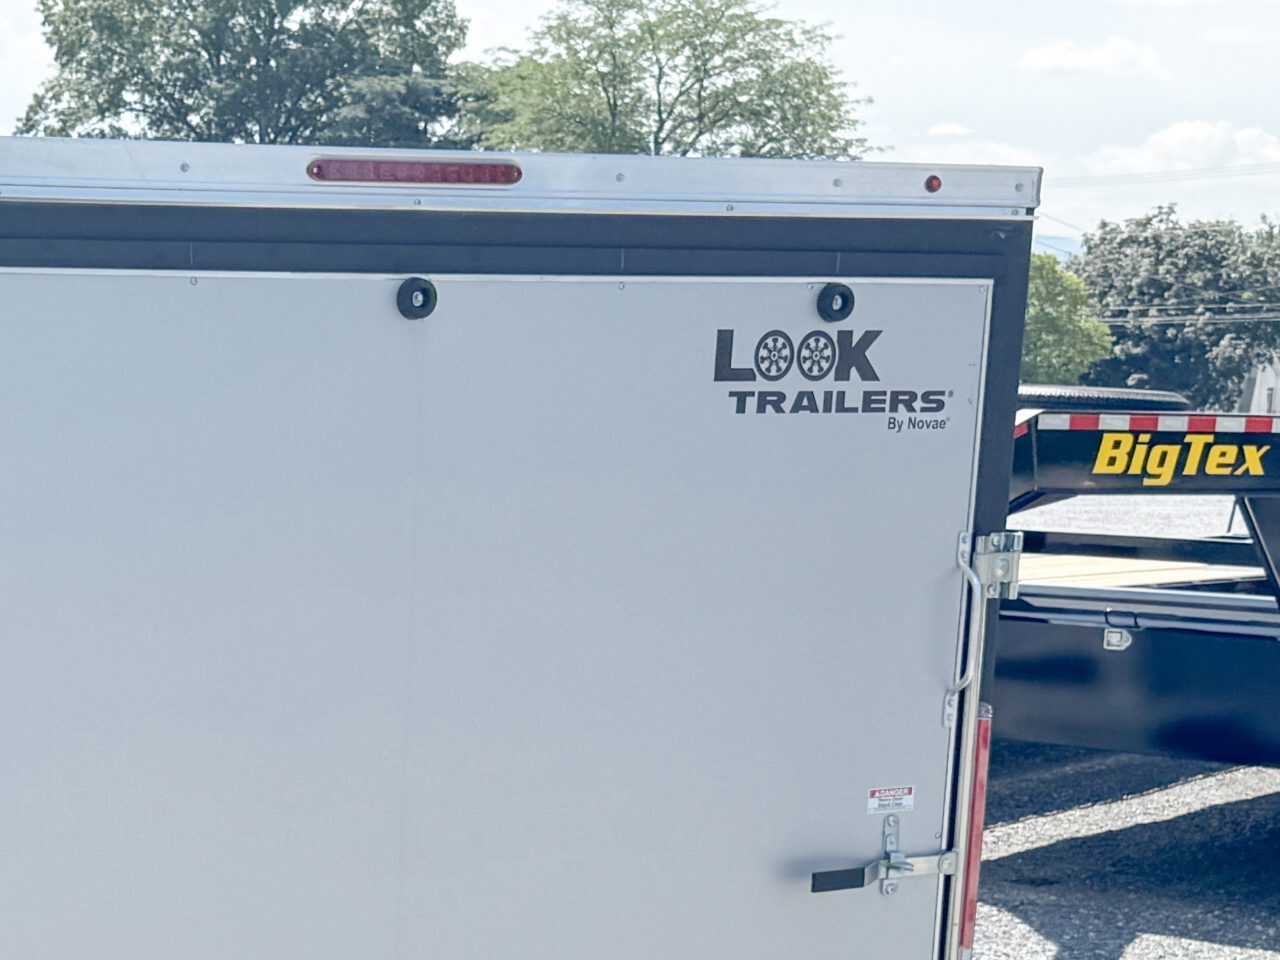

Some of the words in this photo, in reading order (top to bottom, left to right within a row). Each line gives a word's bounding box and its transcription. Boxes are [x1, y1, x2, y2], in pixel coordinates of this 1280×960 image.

[714, 329, 883, 382] LOOK
[728, 390, 946, 414] TRAILERS
[888, 417, 903, 433] By
[907, 416, 946, 430] Novae
[1091, 432, 1271, 487] BigTex
